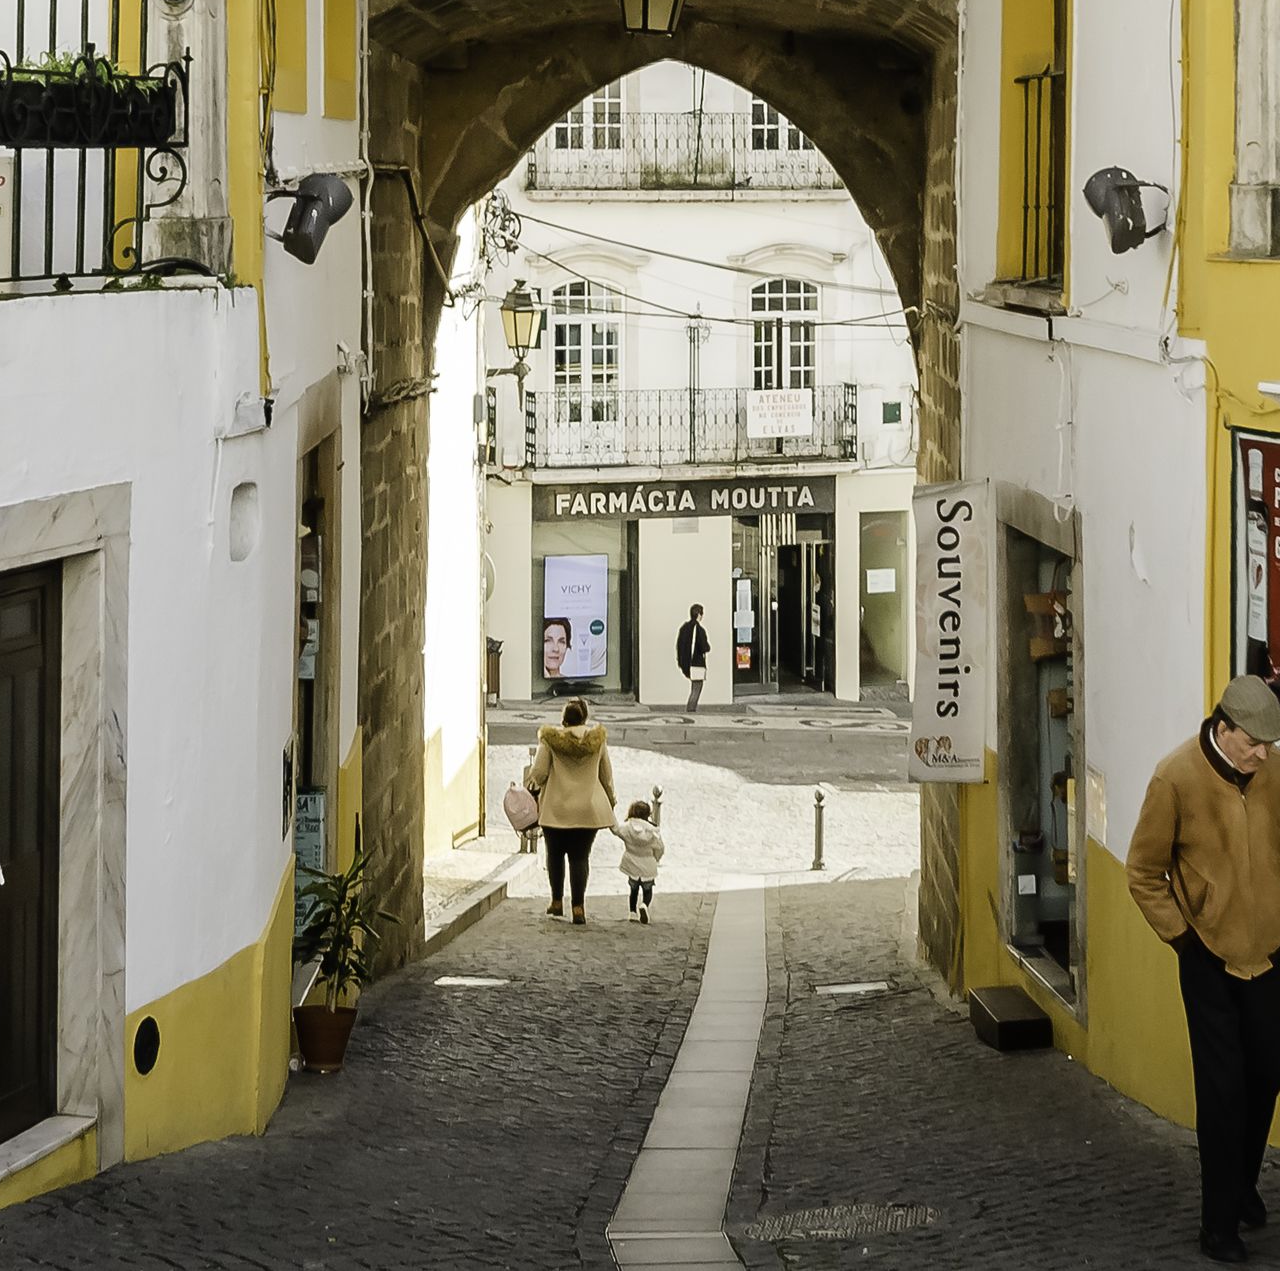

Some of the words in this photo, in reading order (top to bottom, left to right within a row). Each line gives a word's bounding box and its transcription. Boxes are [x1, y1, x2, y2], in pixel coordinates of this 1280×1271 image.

[759, 393, 801, 404] ATENEU
[762, 424, 796, 435] ELVAS
[555, 485, 697, 516] FARMÁCIA
[710, 485, 815, 511] MOUTTA
[560, 584, 592, 595] VICHY
[935, 497, 974, 719] Souvenirs
